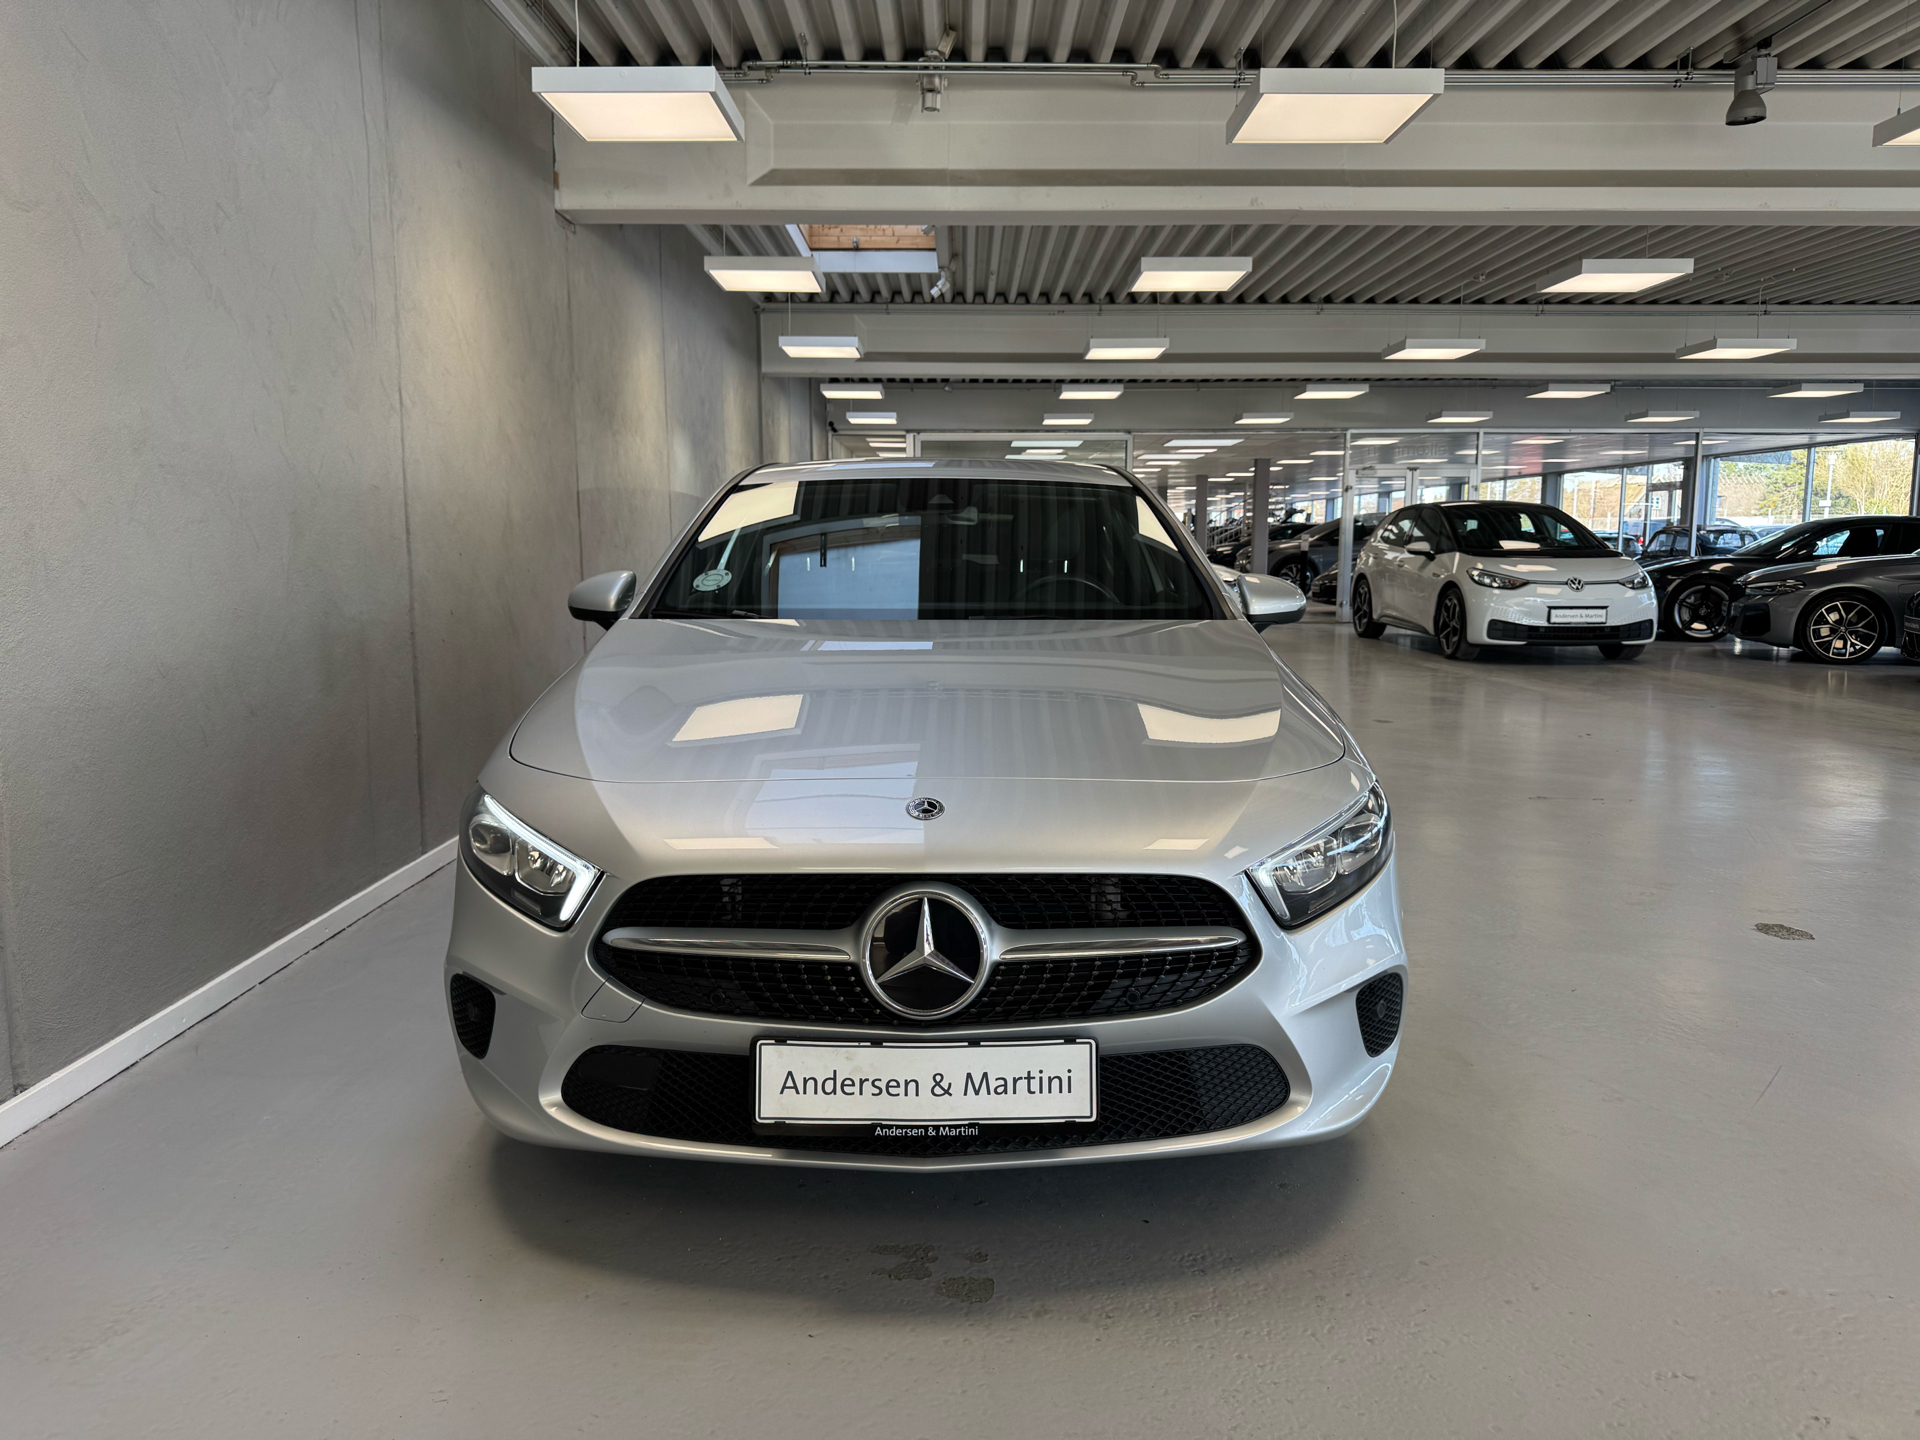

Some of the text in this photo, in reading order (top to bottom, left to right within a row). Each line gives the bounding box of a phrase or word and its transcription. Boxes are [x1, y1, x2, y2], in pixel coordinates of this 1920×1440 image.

[779, 1068, 1073, 1098] Andersen & Martini
[874, 1126, 979, 1136] Andersen & Martini
